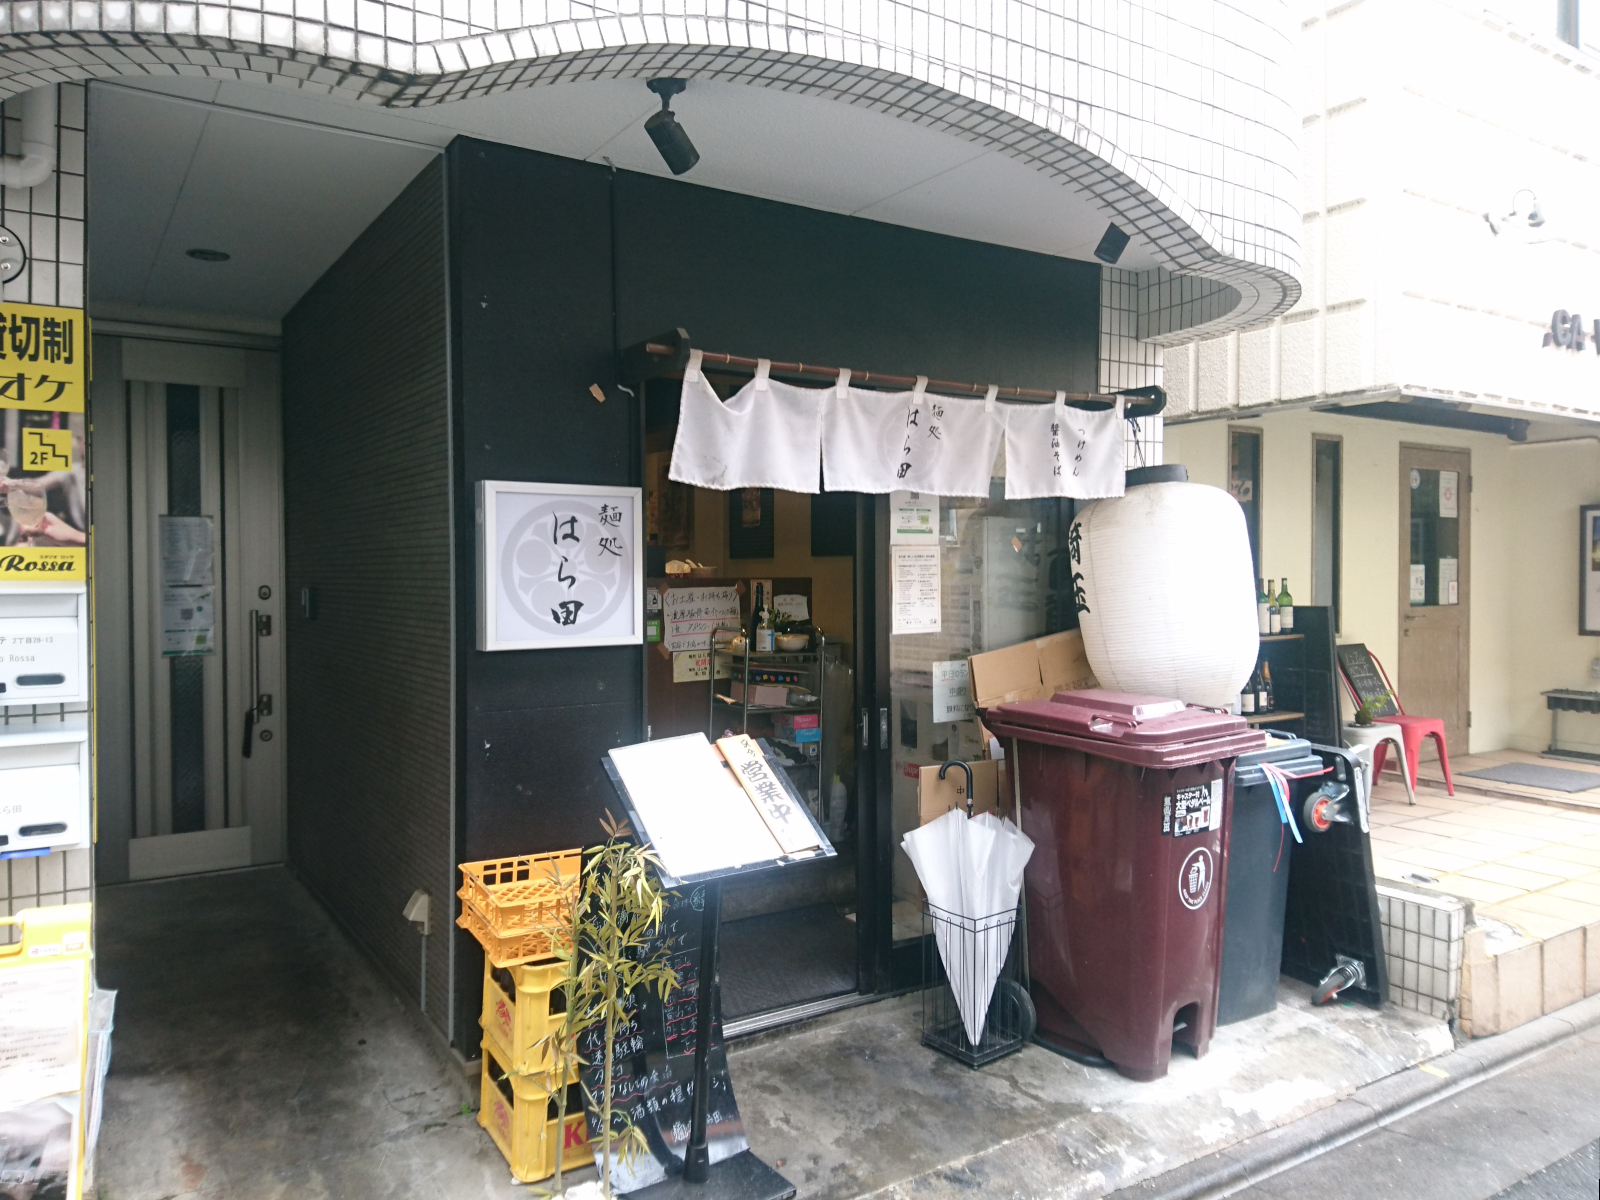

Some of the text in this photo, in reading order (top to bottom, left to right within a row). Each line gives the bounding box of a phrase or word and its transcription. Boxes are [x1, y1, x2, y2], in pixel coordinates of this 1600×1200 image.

[30, 452, 48, 465] 2F
[897, 406, 918, 479] はら田
[1072, 428, 1086, 477] つけめん
[598, 504, 623, 557] 麺処
[0, 554, 76, 571] Rossa
[550, 511, 584, 626] はら田
[9, 654, 35, 662] Rossa
